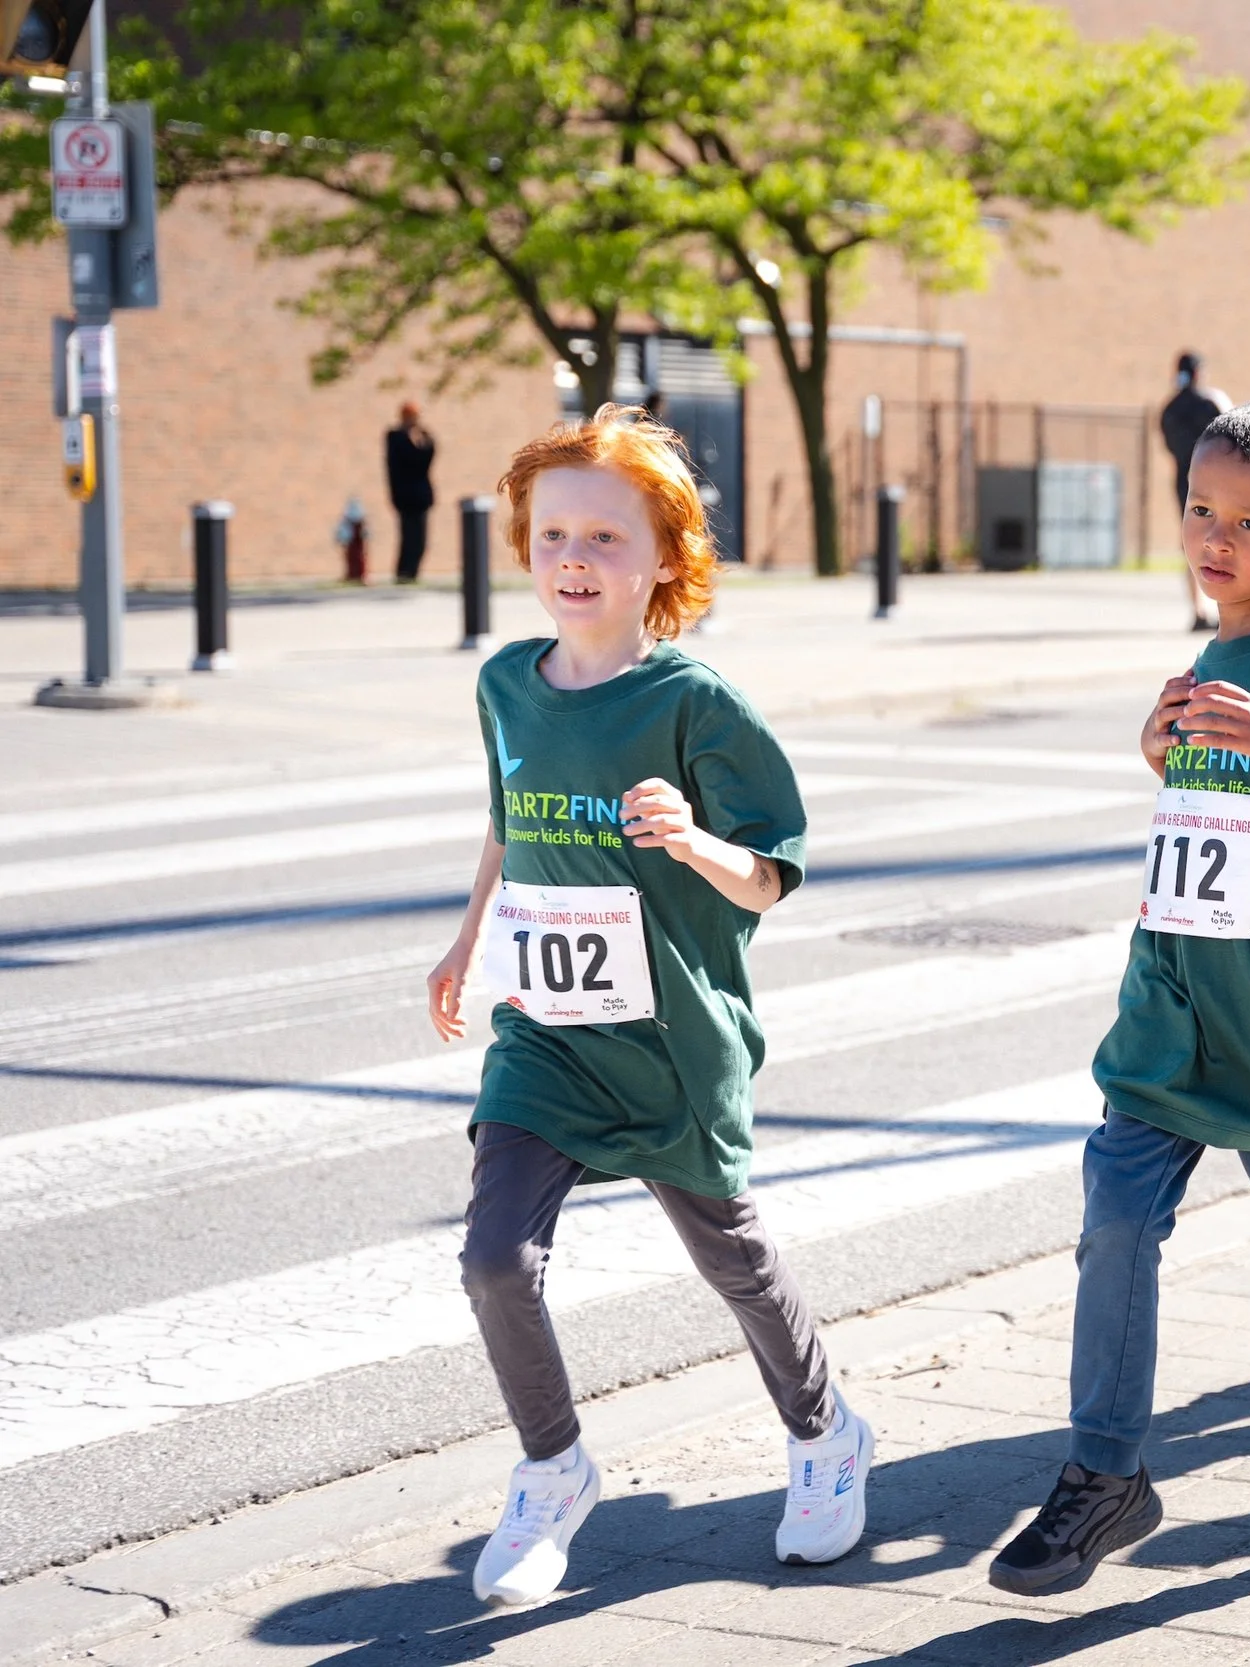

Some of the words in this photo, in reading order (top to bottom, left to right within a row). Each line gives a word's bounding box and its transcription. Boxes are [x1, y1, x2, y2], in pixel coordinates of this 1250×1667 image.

[1182, 778, 1205, 791] kids
[1207, 778, 1226, 793] for
[1228, 780, 1250, 795] life
[1173, 813, 1203, 829] READING
[541, 828, 571, 845] kids
[573, 829, 594, 846] for
[598, 831, 622, 849] life
[1150, 834, 1228, 902] 112
[497, 905, 517, 919] 5KM
[517, 908, 532, 923] RUN
[537, 910, 573, 925] READING
[574, 911, 632, 926] CHALLENGE
[1211, 917, 1219, 925] to
[1219, 917, 1235, 927] Play
[1212, 909, 1233, 919] Made
[512, 930, 614, 994] 102
[603, 997, 625, 1005] Made
[612, 1003, 628, 1012] Play
[544, 1009, 570, 1017] running
